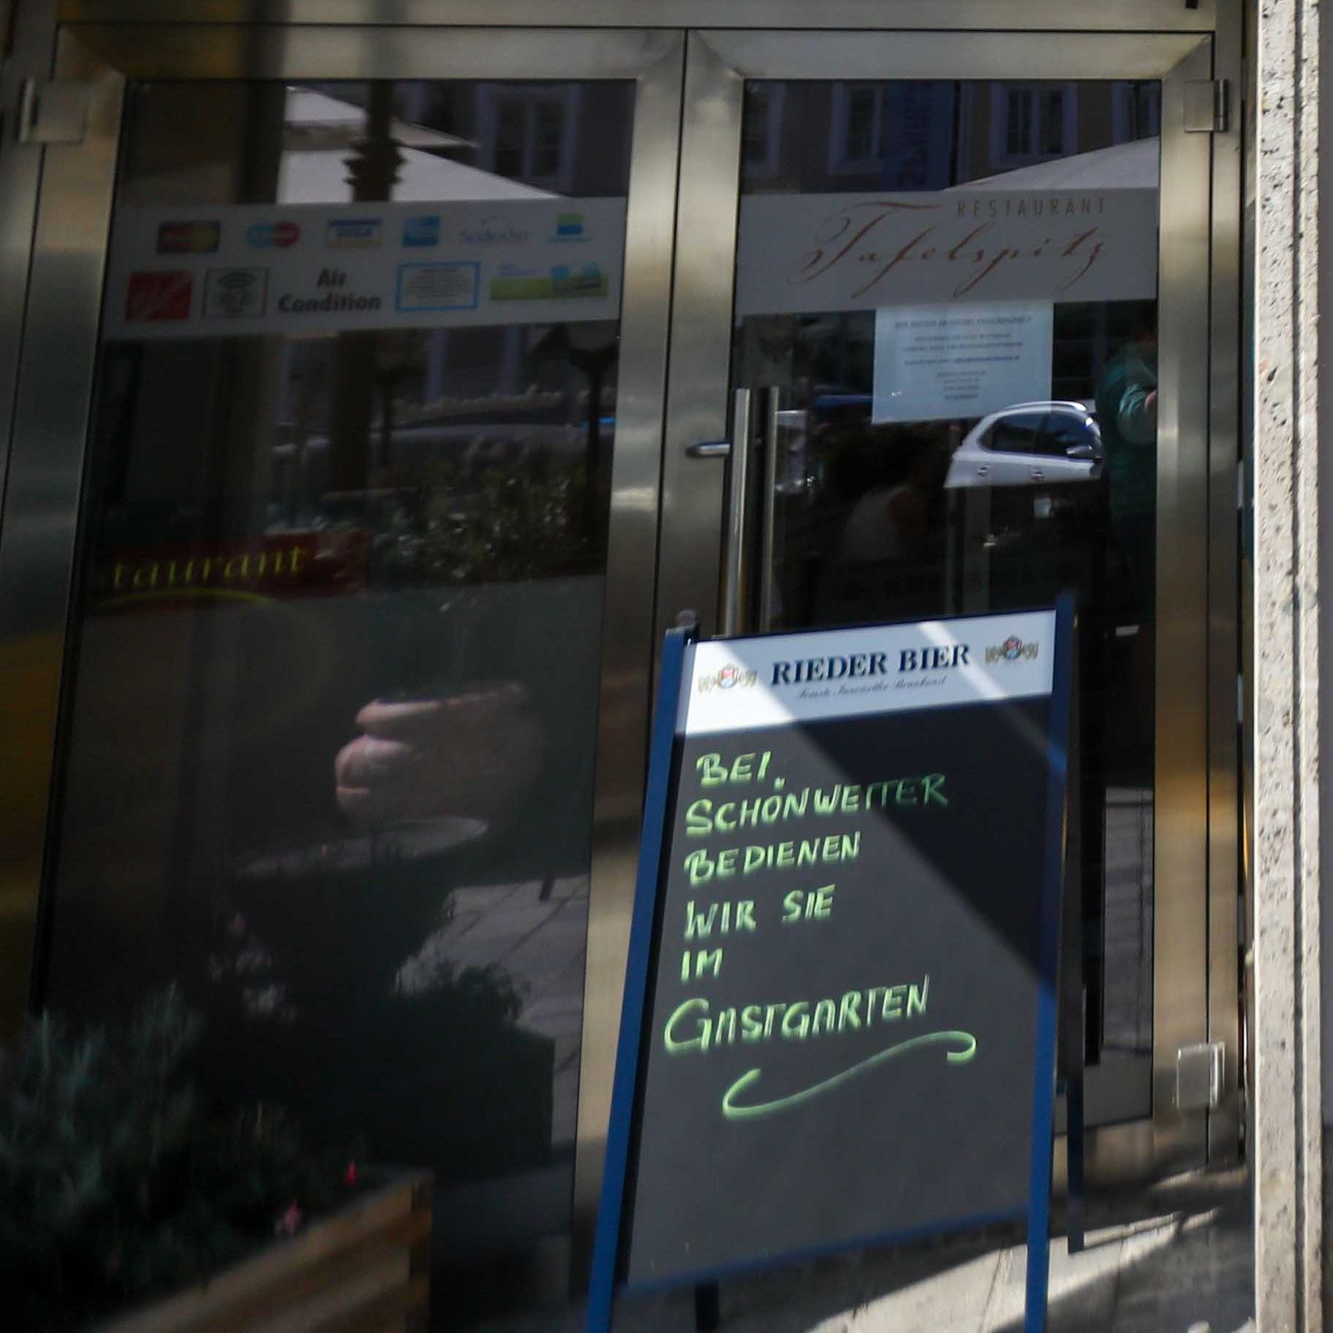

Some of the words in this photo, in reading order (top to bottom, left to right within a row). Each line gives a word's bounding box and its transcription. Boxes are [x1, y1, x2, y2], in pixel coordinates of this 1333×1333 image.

[957, 198, 1106, 218] RESTAURANT
[788, 201, 1112, 298] Tafelspitz
[317, 268, 347, 288] Air
[278, 293, 382, 313] Condition
[770, 652, 888, 686] RIEDER
[897, 643, 972, 672] BIER
[683, 830, 861, 888] BEDIENEN
[684, 899, 757, 941] WIR
[781, 884, 837, 923] SIE
[680, 948, 724, 984] IM
[664, 974, 931, 1058] GASTGARTEN
